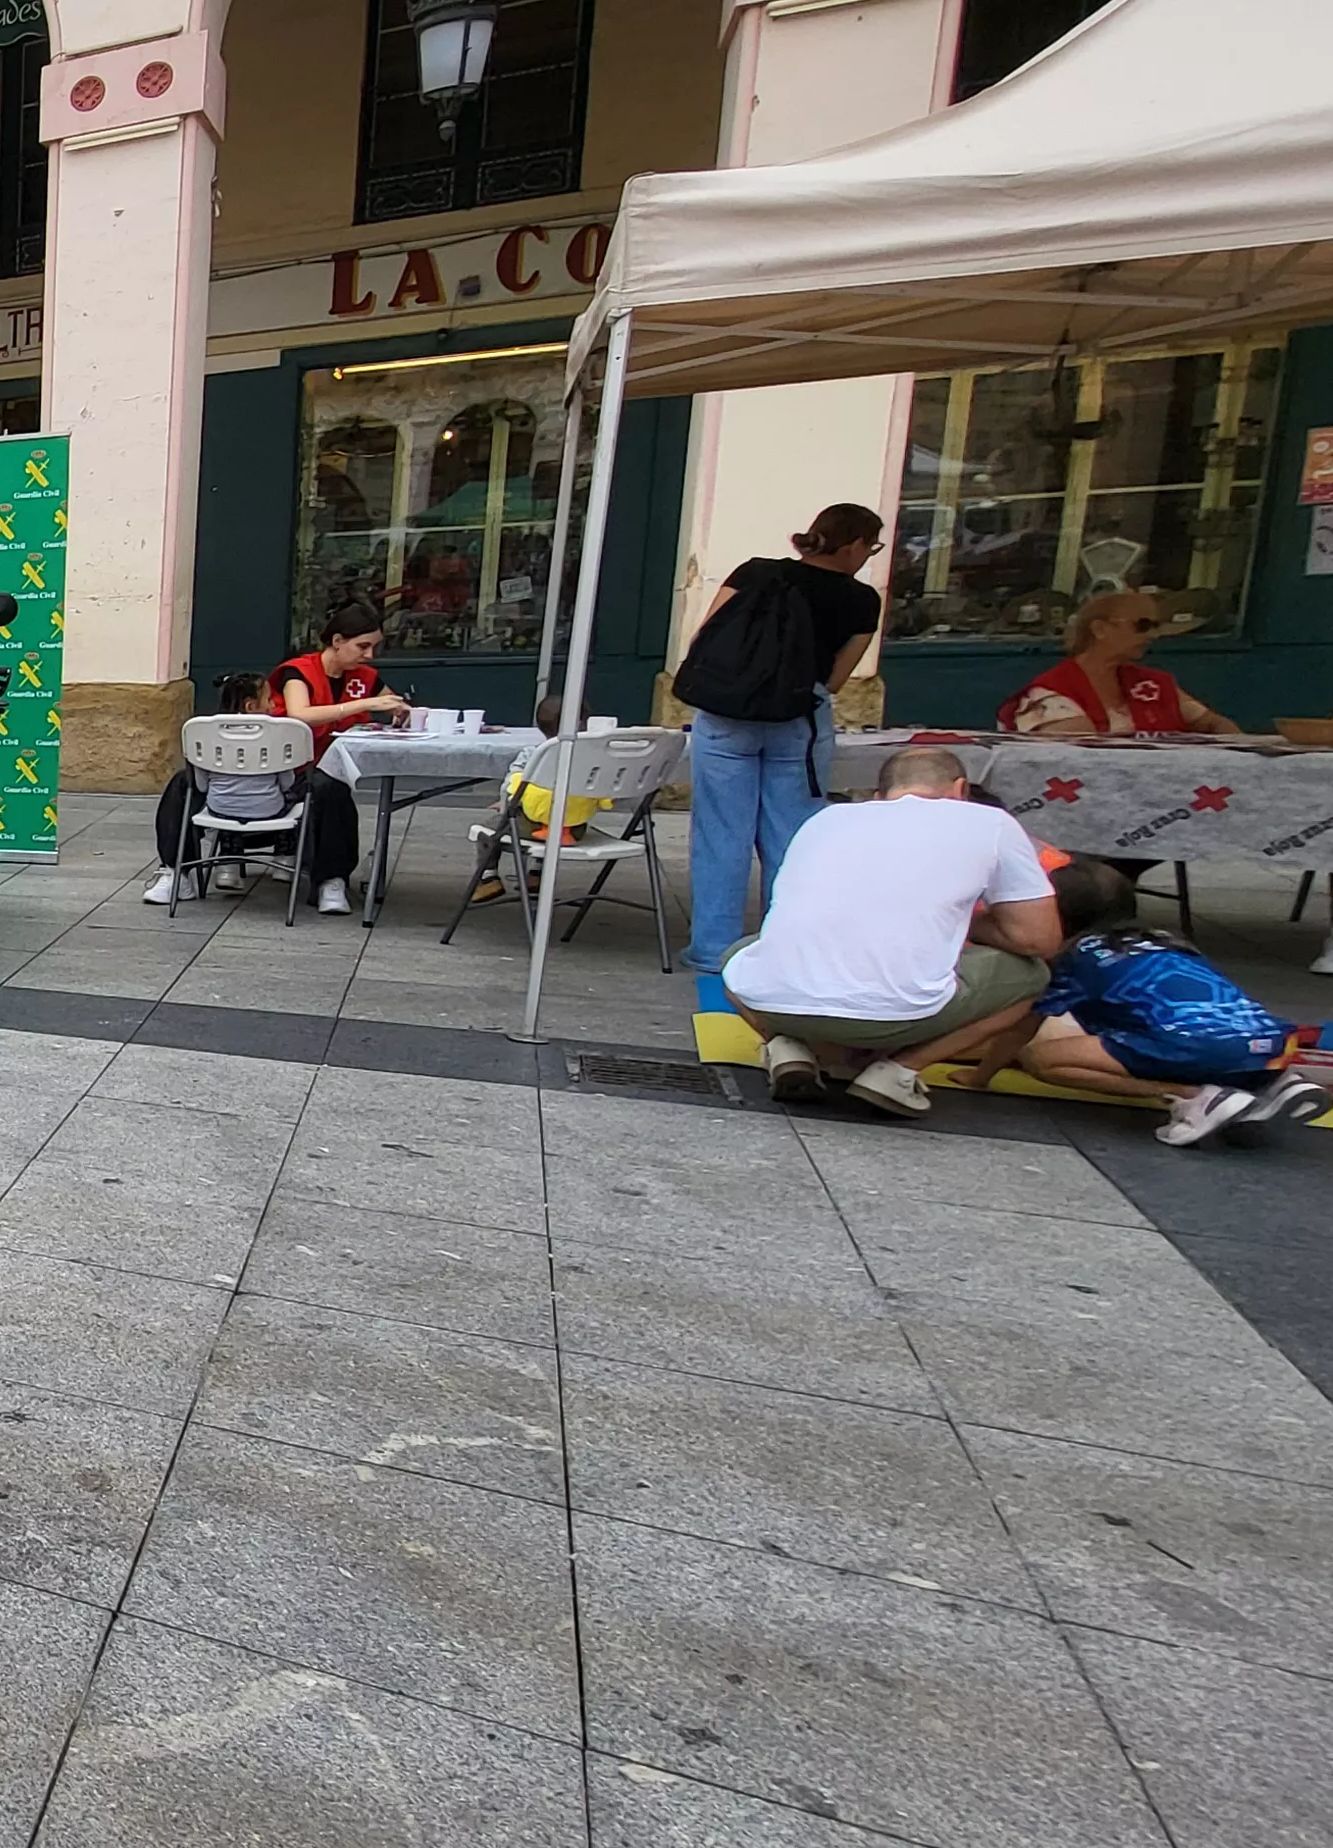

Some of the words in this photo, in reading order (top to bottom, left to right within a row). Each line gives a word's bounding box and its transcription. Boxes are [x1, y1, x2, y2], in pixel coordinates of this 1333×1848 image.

[329, 249, 447, 317] LA
[1010, 797, 1045, 815] Cru
[1150, 808, 1192, 831] Cruz
